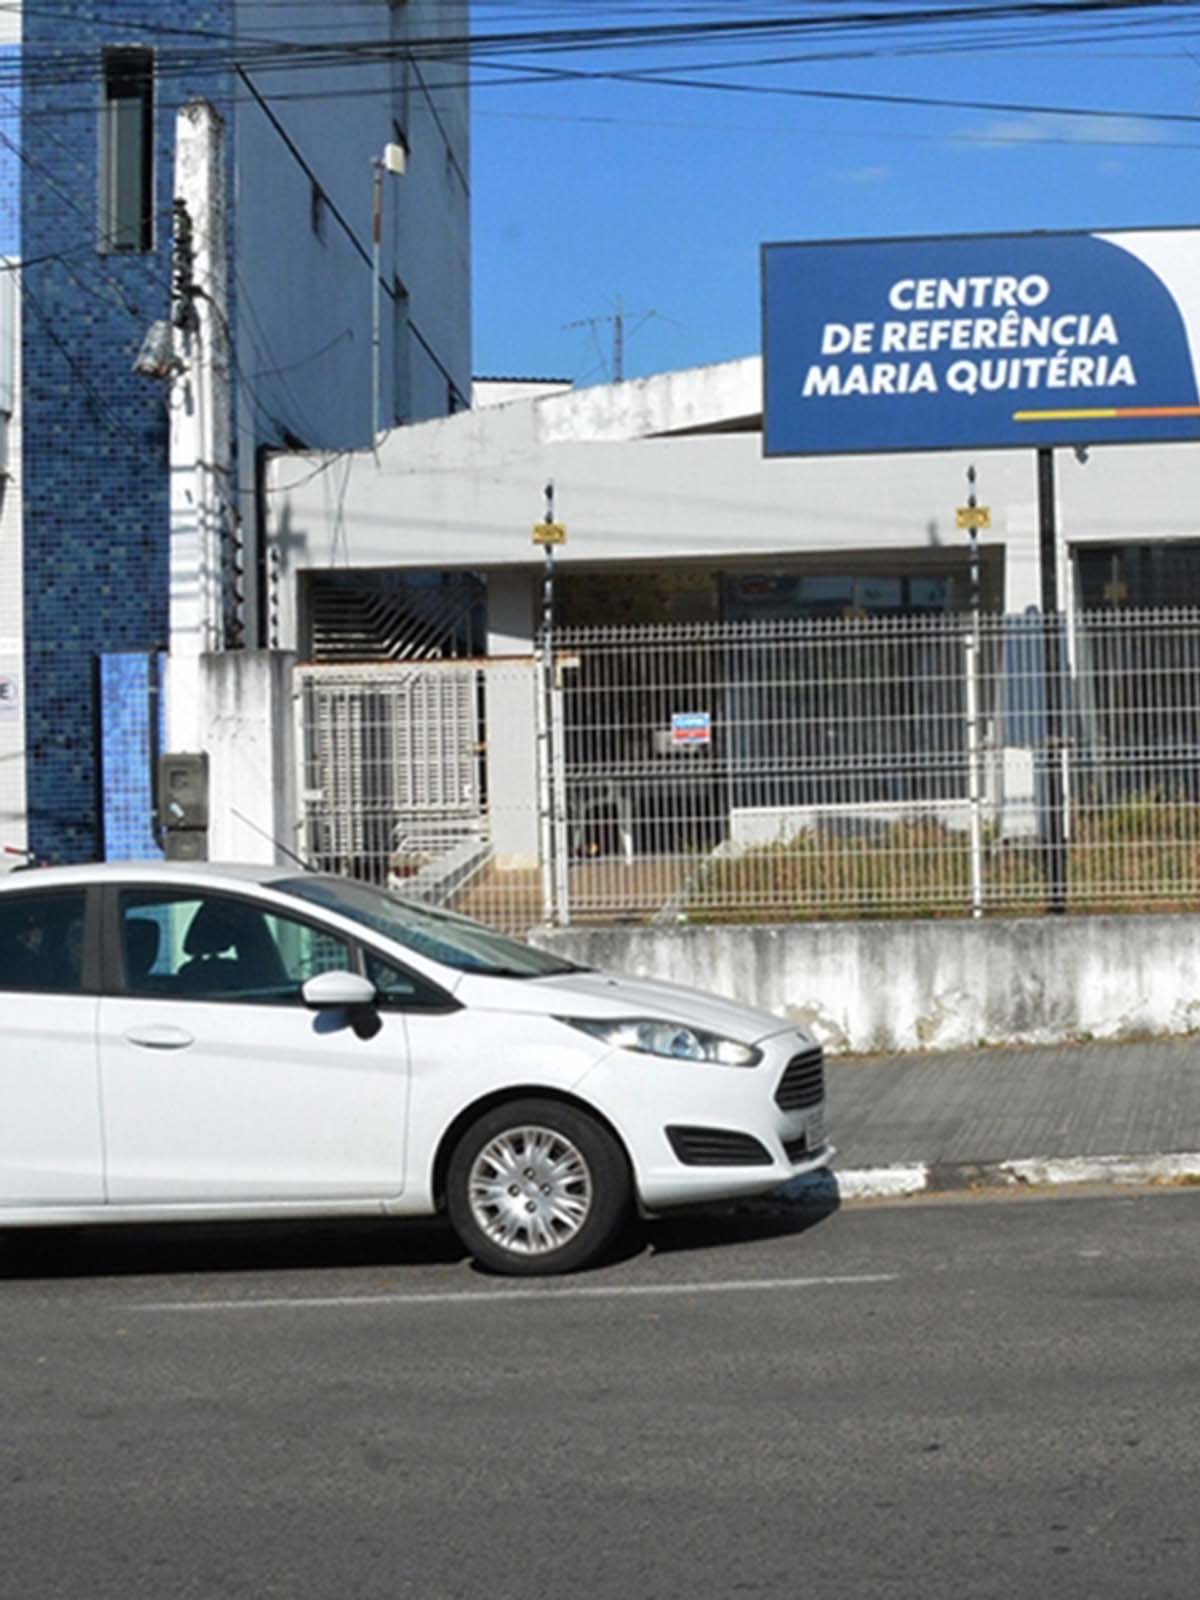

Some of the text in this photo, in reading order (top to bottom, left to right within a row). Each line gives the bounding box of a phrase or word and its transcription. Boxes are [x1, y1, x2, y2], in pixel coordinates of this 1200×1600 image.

[889, 275, 1050, 310] CENTRO
[821, 311, 1119, 355] DE REFERÊNCIA
[802, 350, 1137, 396] MARIA QUITÉRIA
